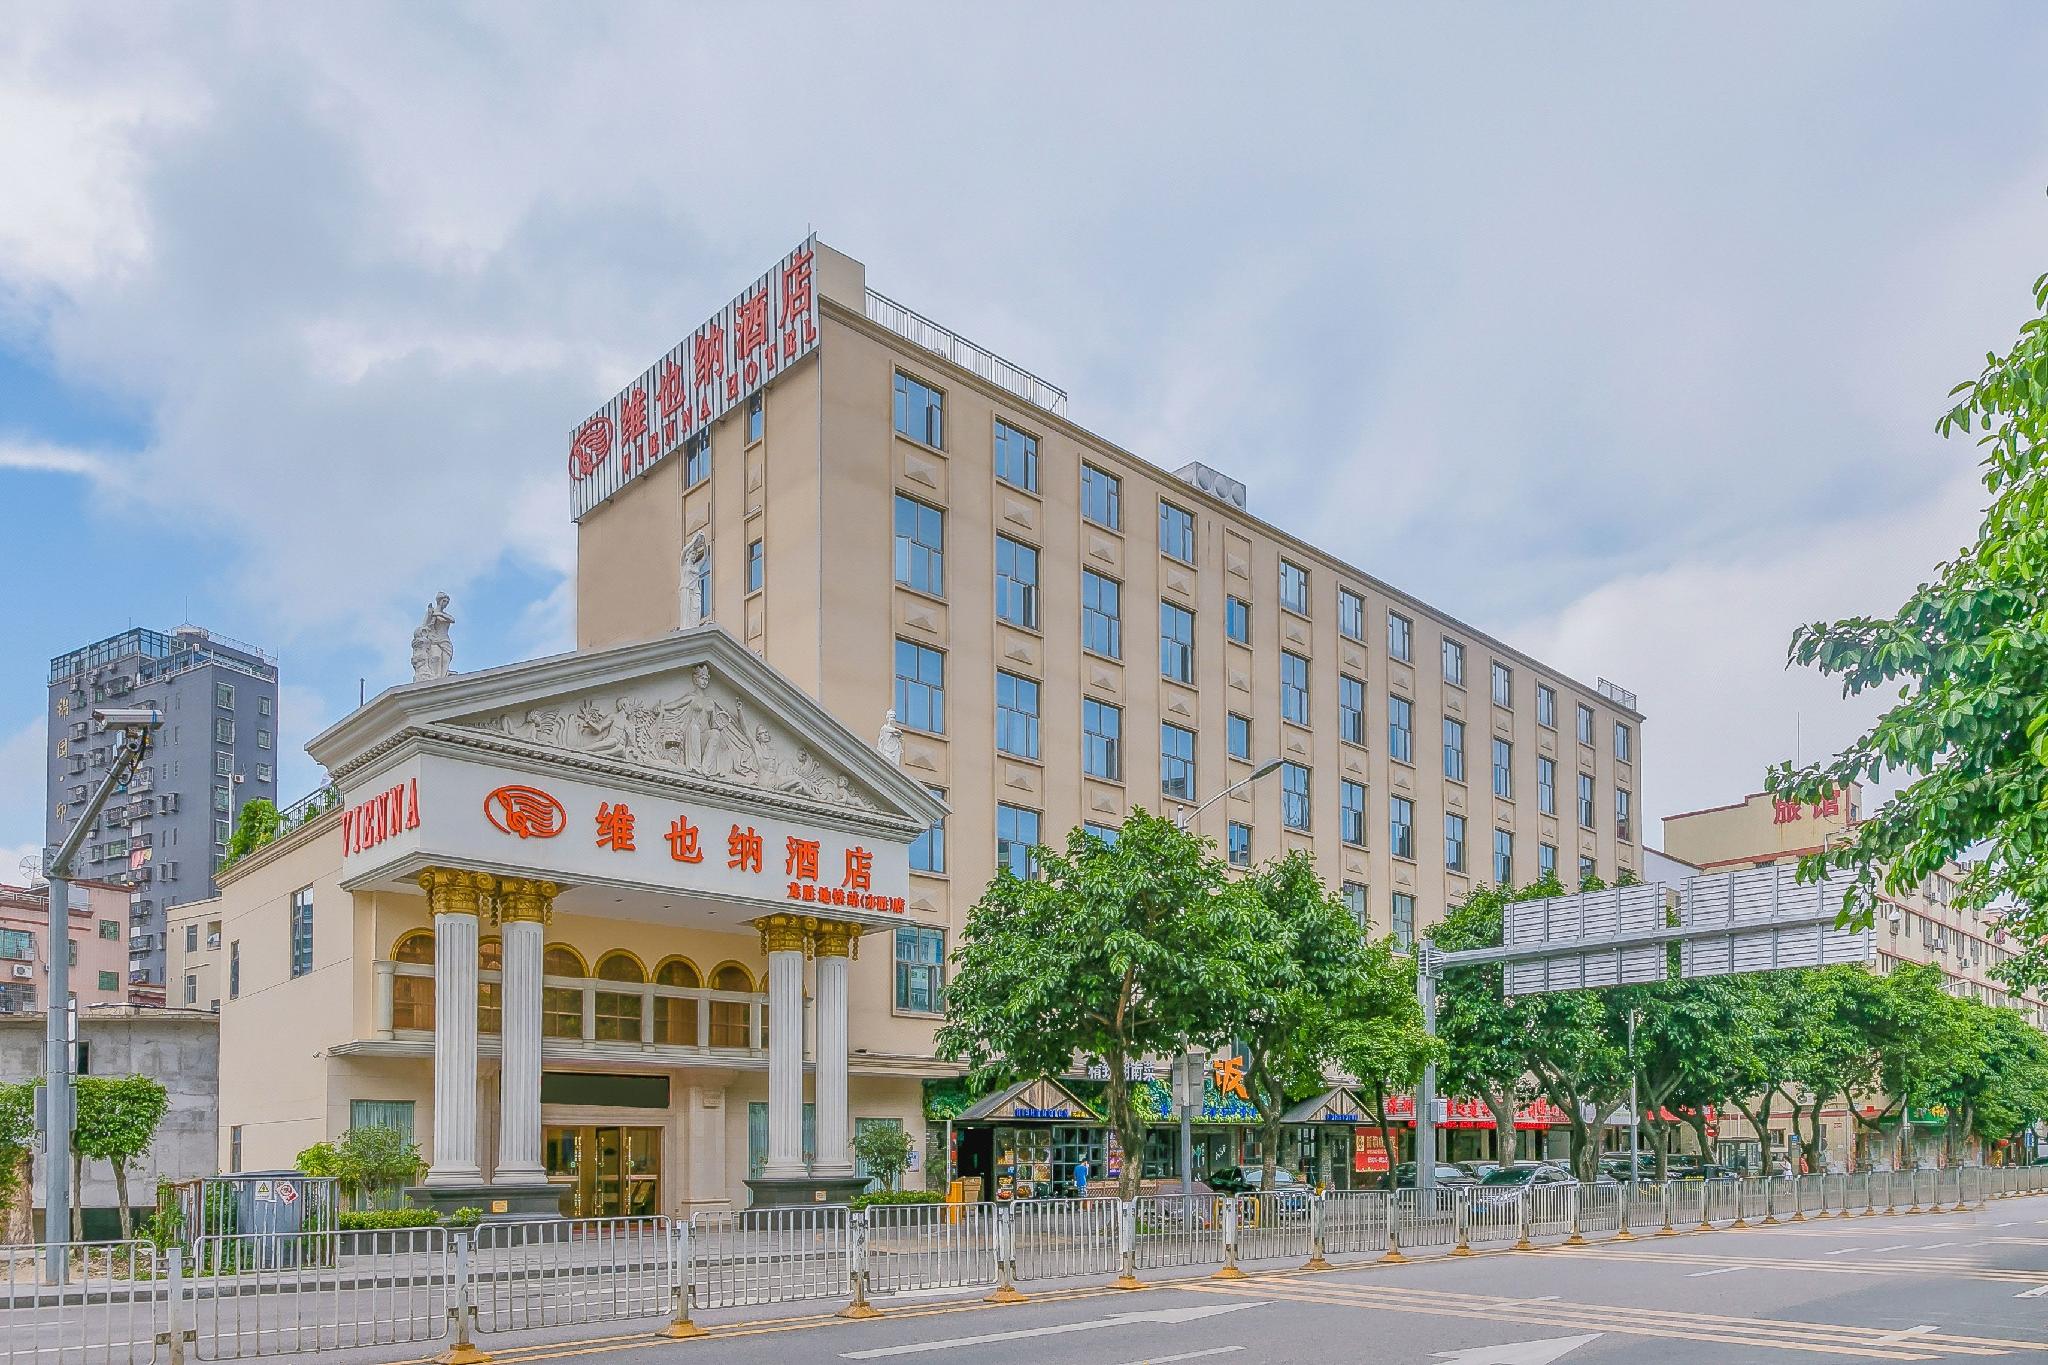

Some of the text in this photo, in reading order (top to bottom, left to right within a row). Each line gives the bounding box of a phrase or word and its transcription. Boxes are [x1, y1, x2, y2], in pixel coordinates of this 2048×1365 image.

[620, 249, 815, 448] 维也纳酒店
[622, 317, 817, 475] VIENNA HOTEL
[341, 777, 421, 858] VIENNA
[595, 800, 874, 893] 维也纳酒店
